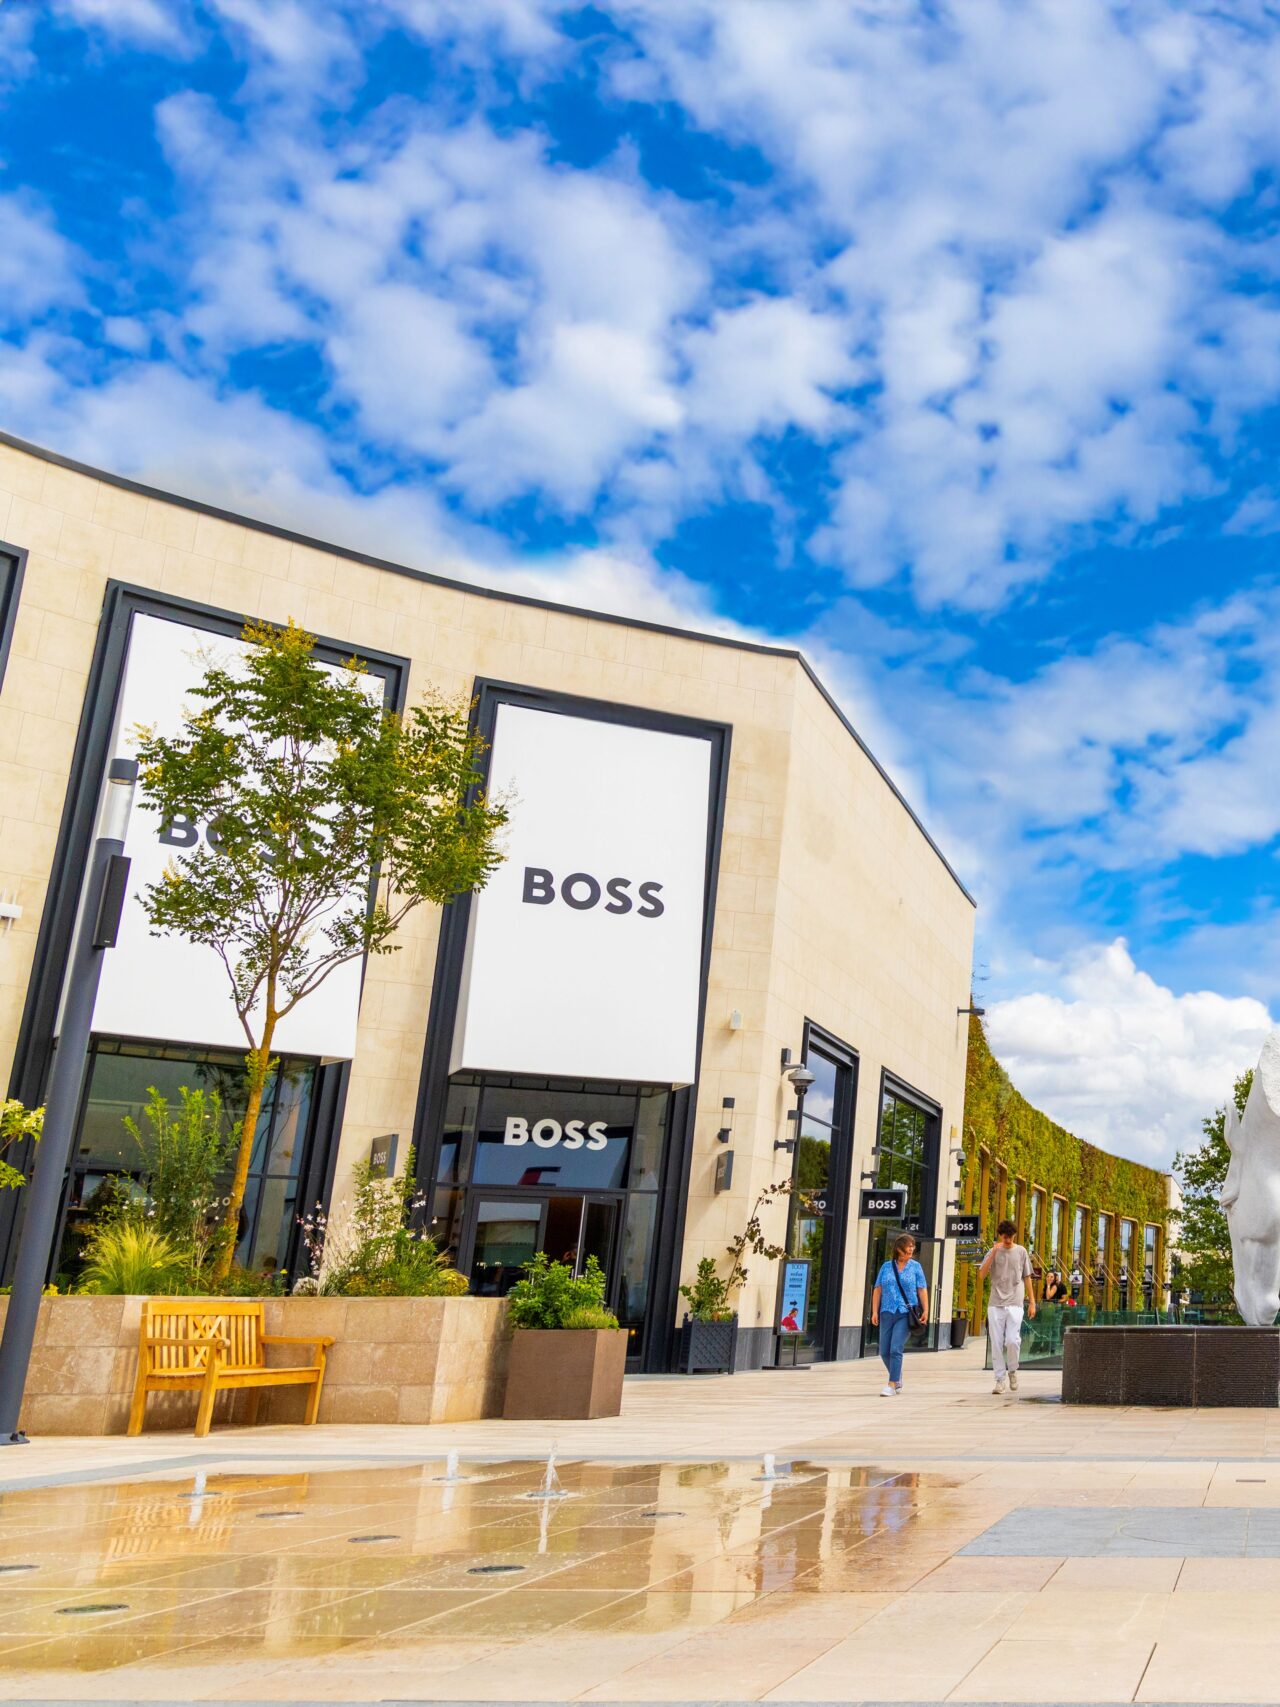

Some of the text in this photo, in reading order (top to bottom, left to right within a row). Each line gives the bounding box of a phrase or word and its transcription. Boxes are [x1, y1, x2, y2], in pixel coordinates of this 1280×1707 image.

[522, 866, 665, 918] BOSS
[503, 1116, 608, 1151] BOSS
[373, 1151, 387, 1165] BOSS
[868, 1200, 897, 1209] BOSS
[951, 1223, 974, 1231] BOSS
